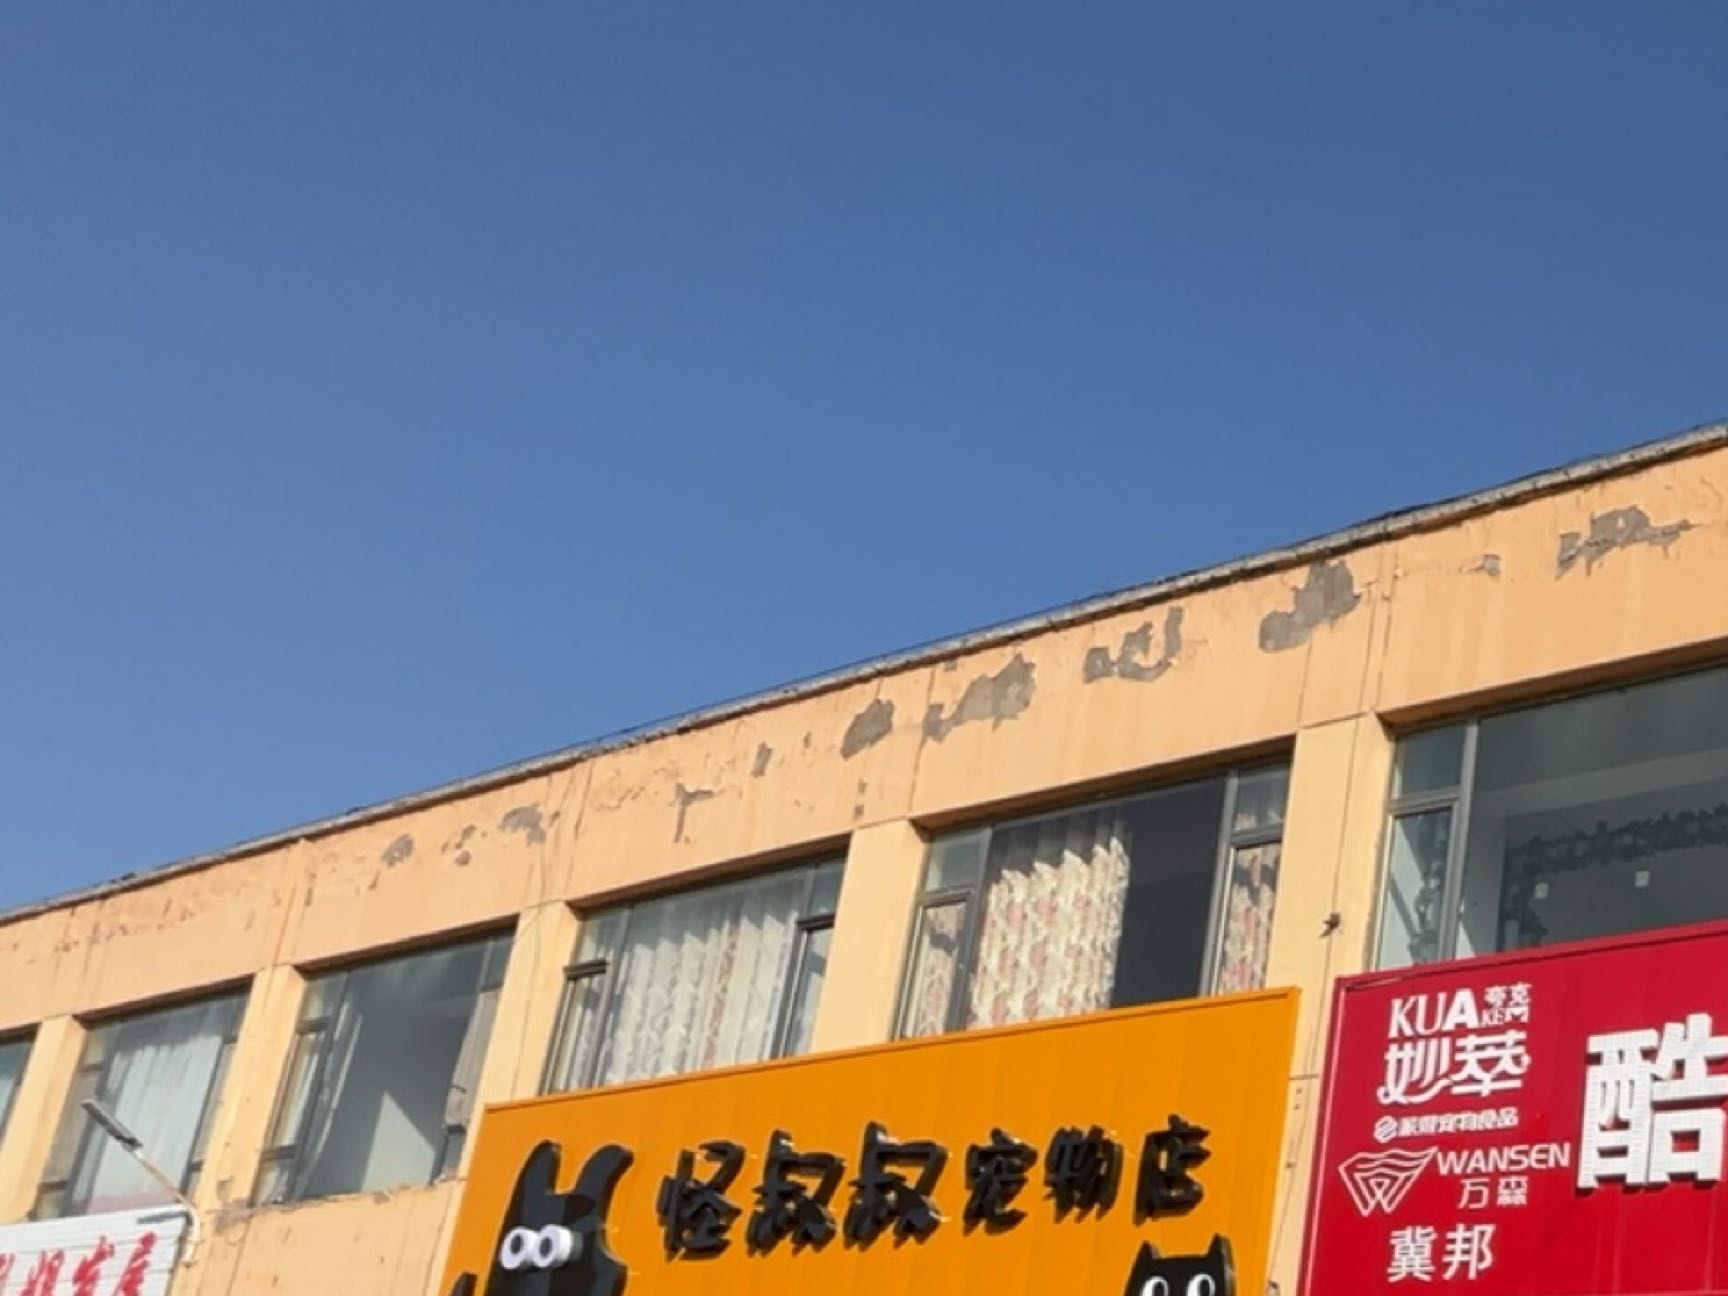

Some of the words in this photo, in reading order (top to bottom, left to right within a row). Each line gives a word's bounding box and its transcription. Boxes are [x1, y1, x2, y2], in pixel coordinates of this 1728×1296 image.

[1388, 988, 1479, 1039] KUA
[1437, 1142, 1571, 1176] WANSEN
[657, 1114, 1210, 1262] 怪叔叔宠物店
[1459, 1175, 1528, 1209] 万森
[1387, 1222, 1497, 1283] 冀邦
